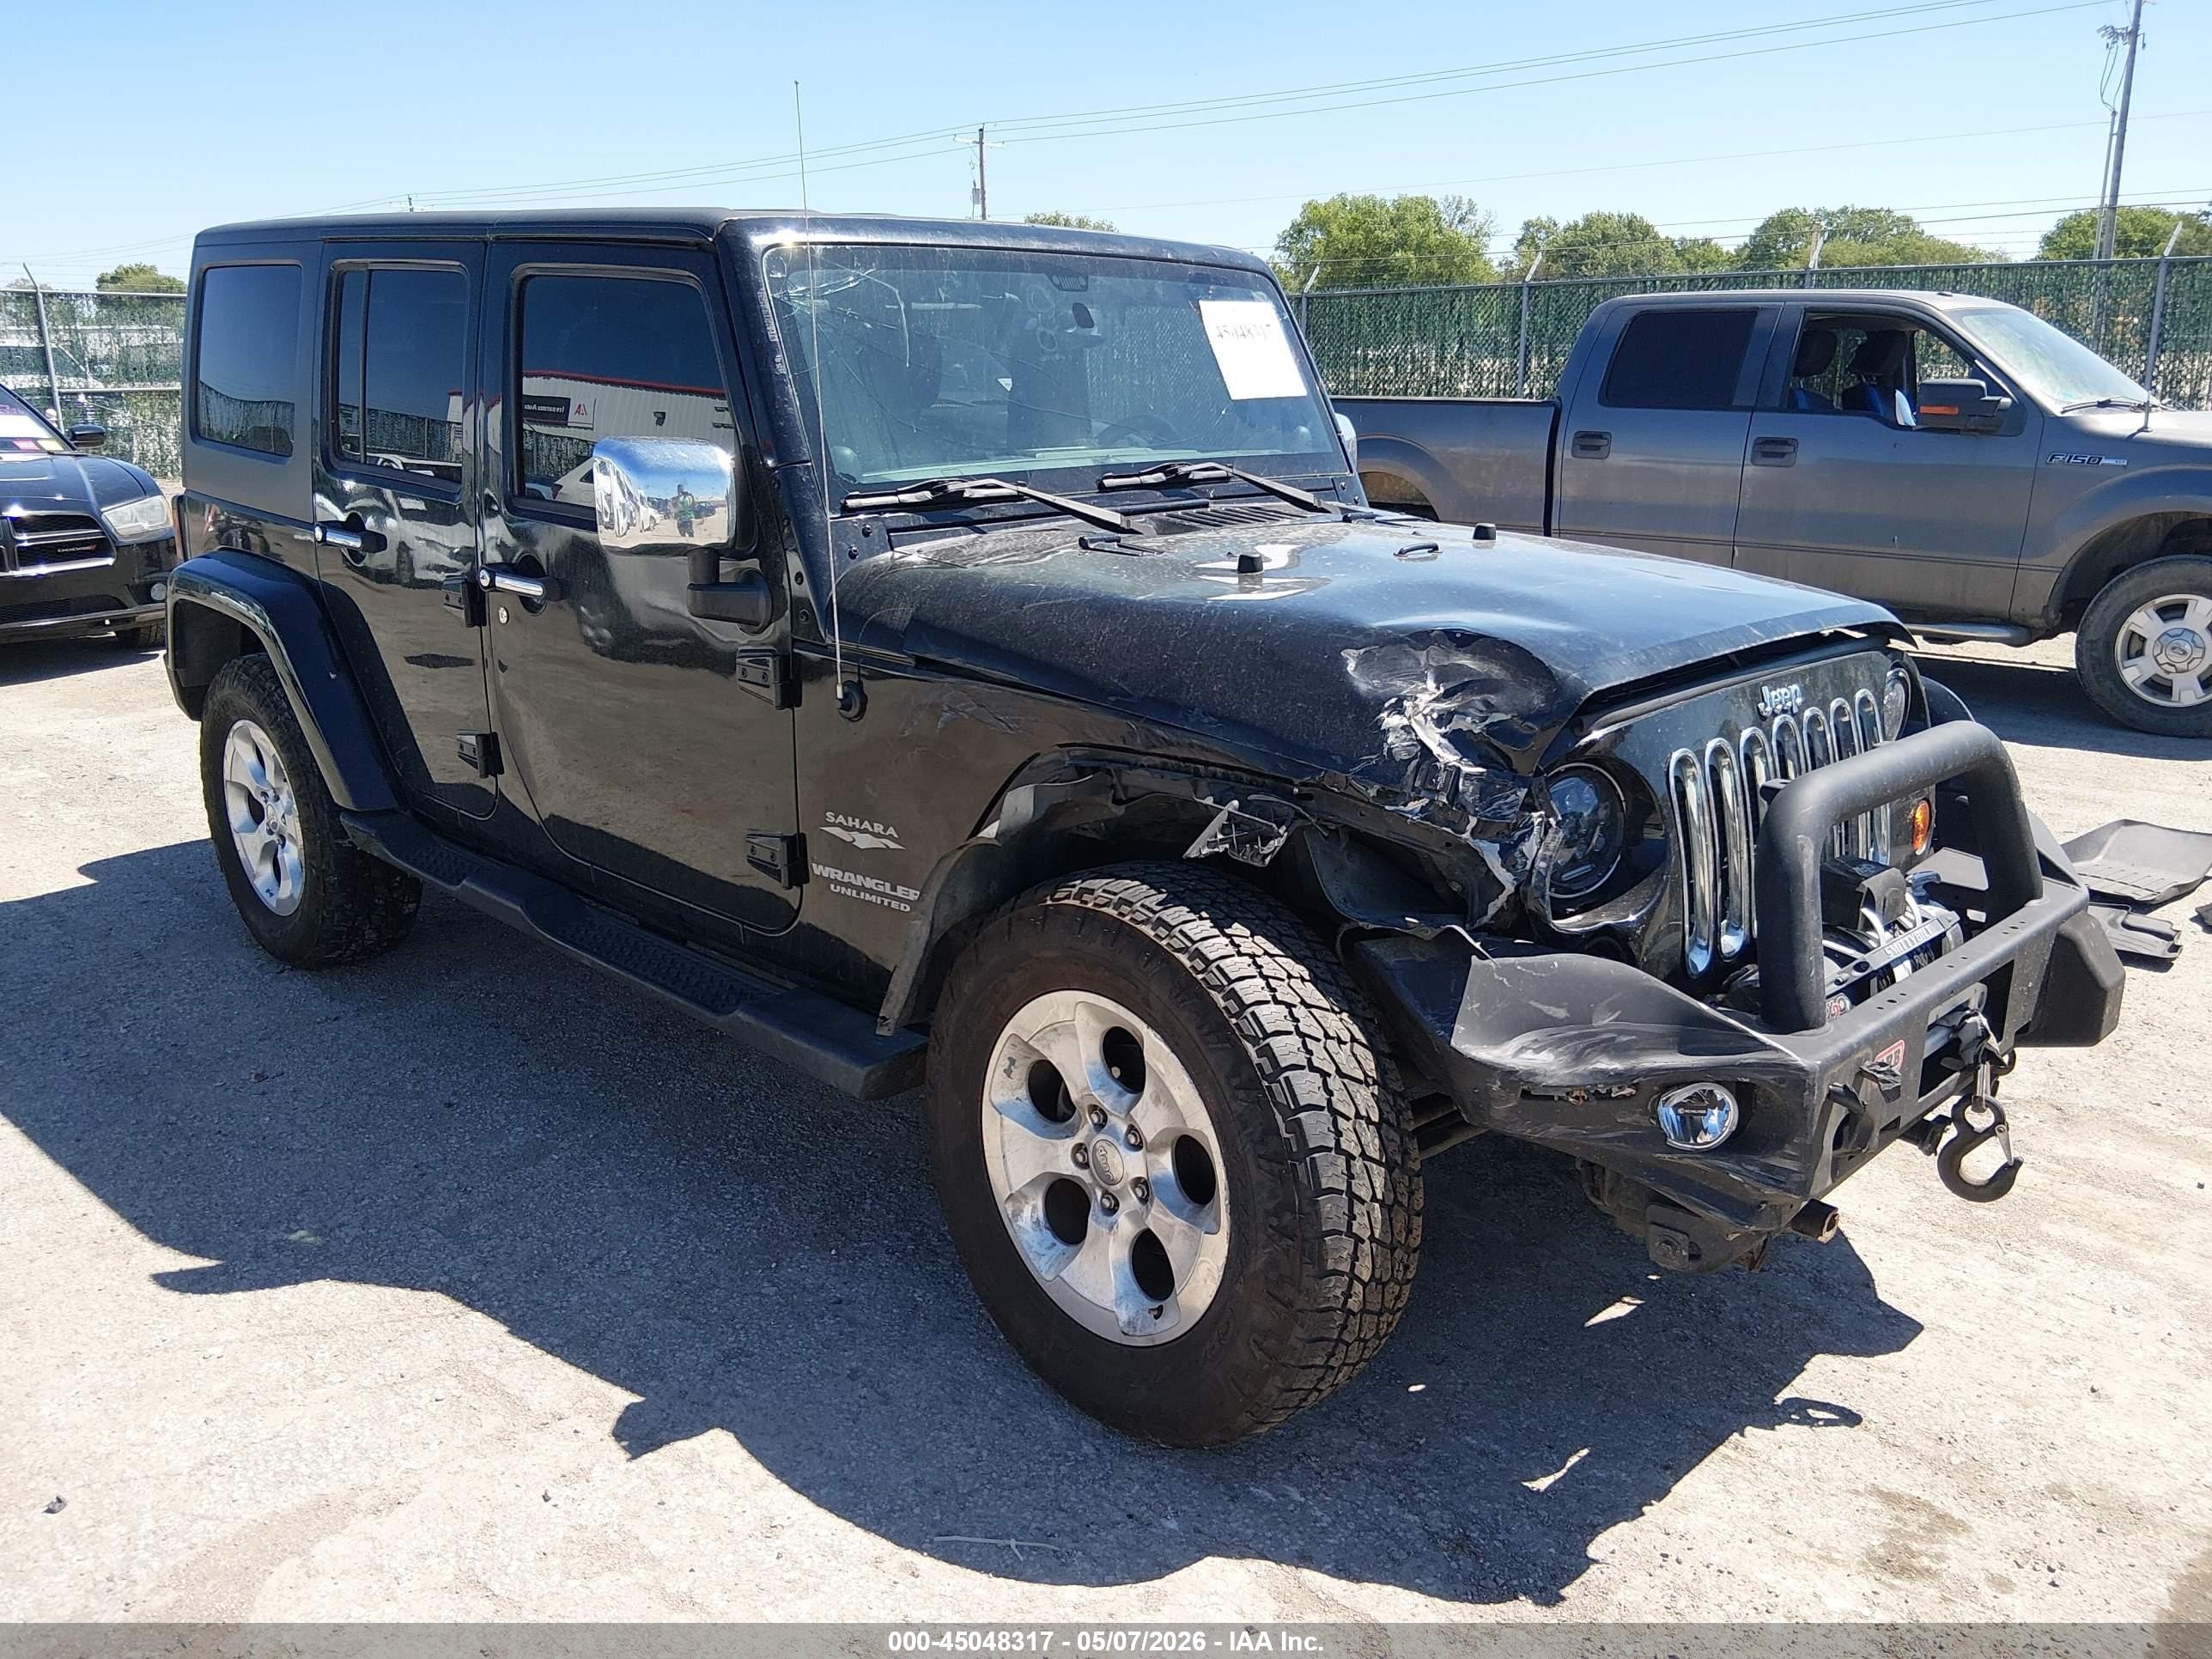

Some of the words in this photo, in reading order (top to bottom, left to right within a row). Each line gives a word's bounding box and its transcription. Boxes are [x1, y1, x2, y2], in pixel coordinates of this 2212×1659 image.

[2047, 453, 2105, 465] F-150
[1758, 684, 1802, 716] Jeep
[825, 811, 899, 838] SAHARA
[811, 862, 921, 901] WRANGLER
[830, 884, 911, 911] UNLIMITED
